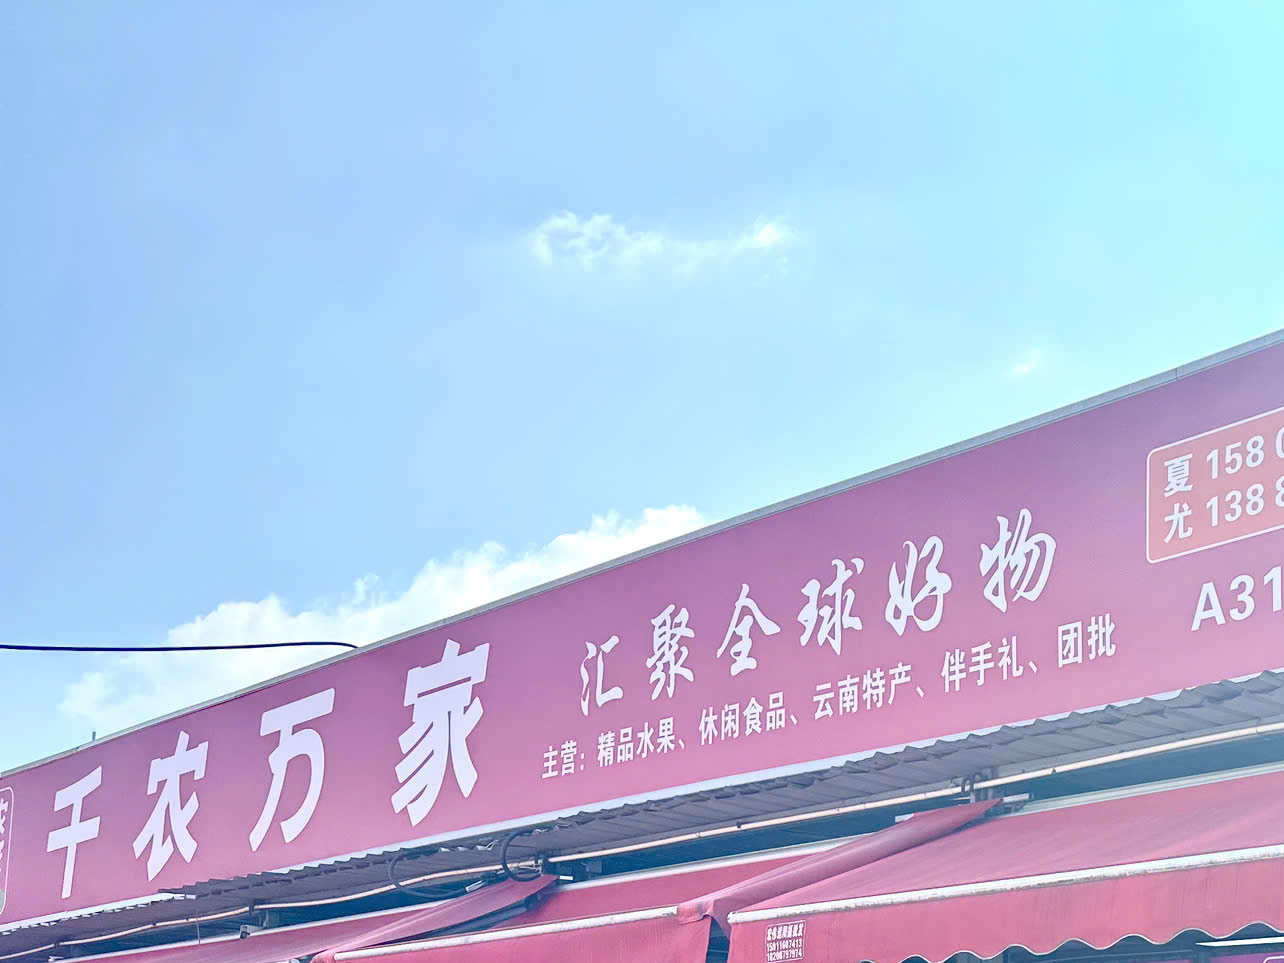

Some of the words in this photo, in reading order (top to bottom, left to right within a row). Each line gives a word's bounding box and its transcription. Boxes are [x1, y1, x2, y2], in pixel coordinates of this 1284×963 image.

[1164, 454, 1193, 497] 夏
[1206, 435, 1265, 480] 158
[1164, 503, 1193, 543] 尤
[1206, 483, 1264, 527] 138
[580, 508, 1056, 716] 汇聚全球好物
[46, 639, 490, 899] 千农万家
